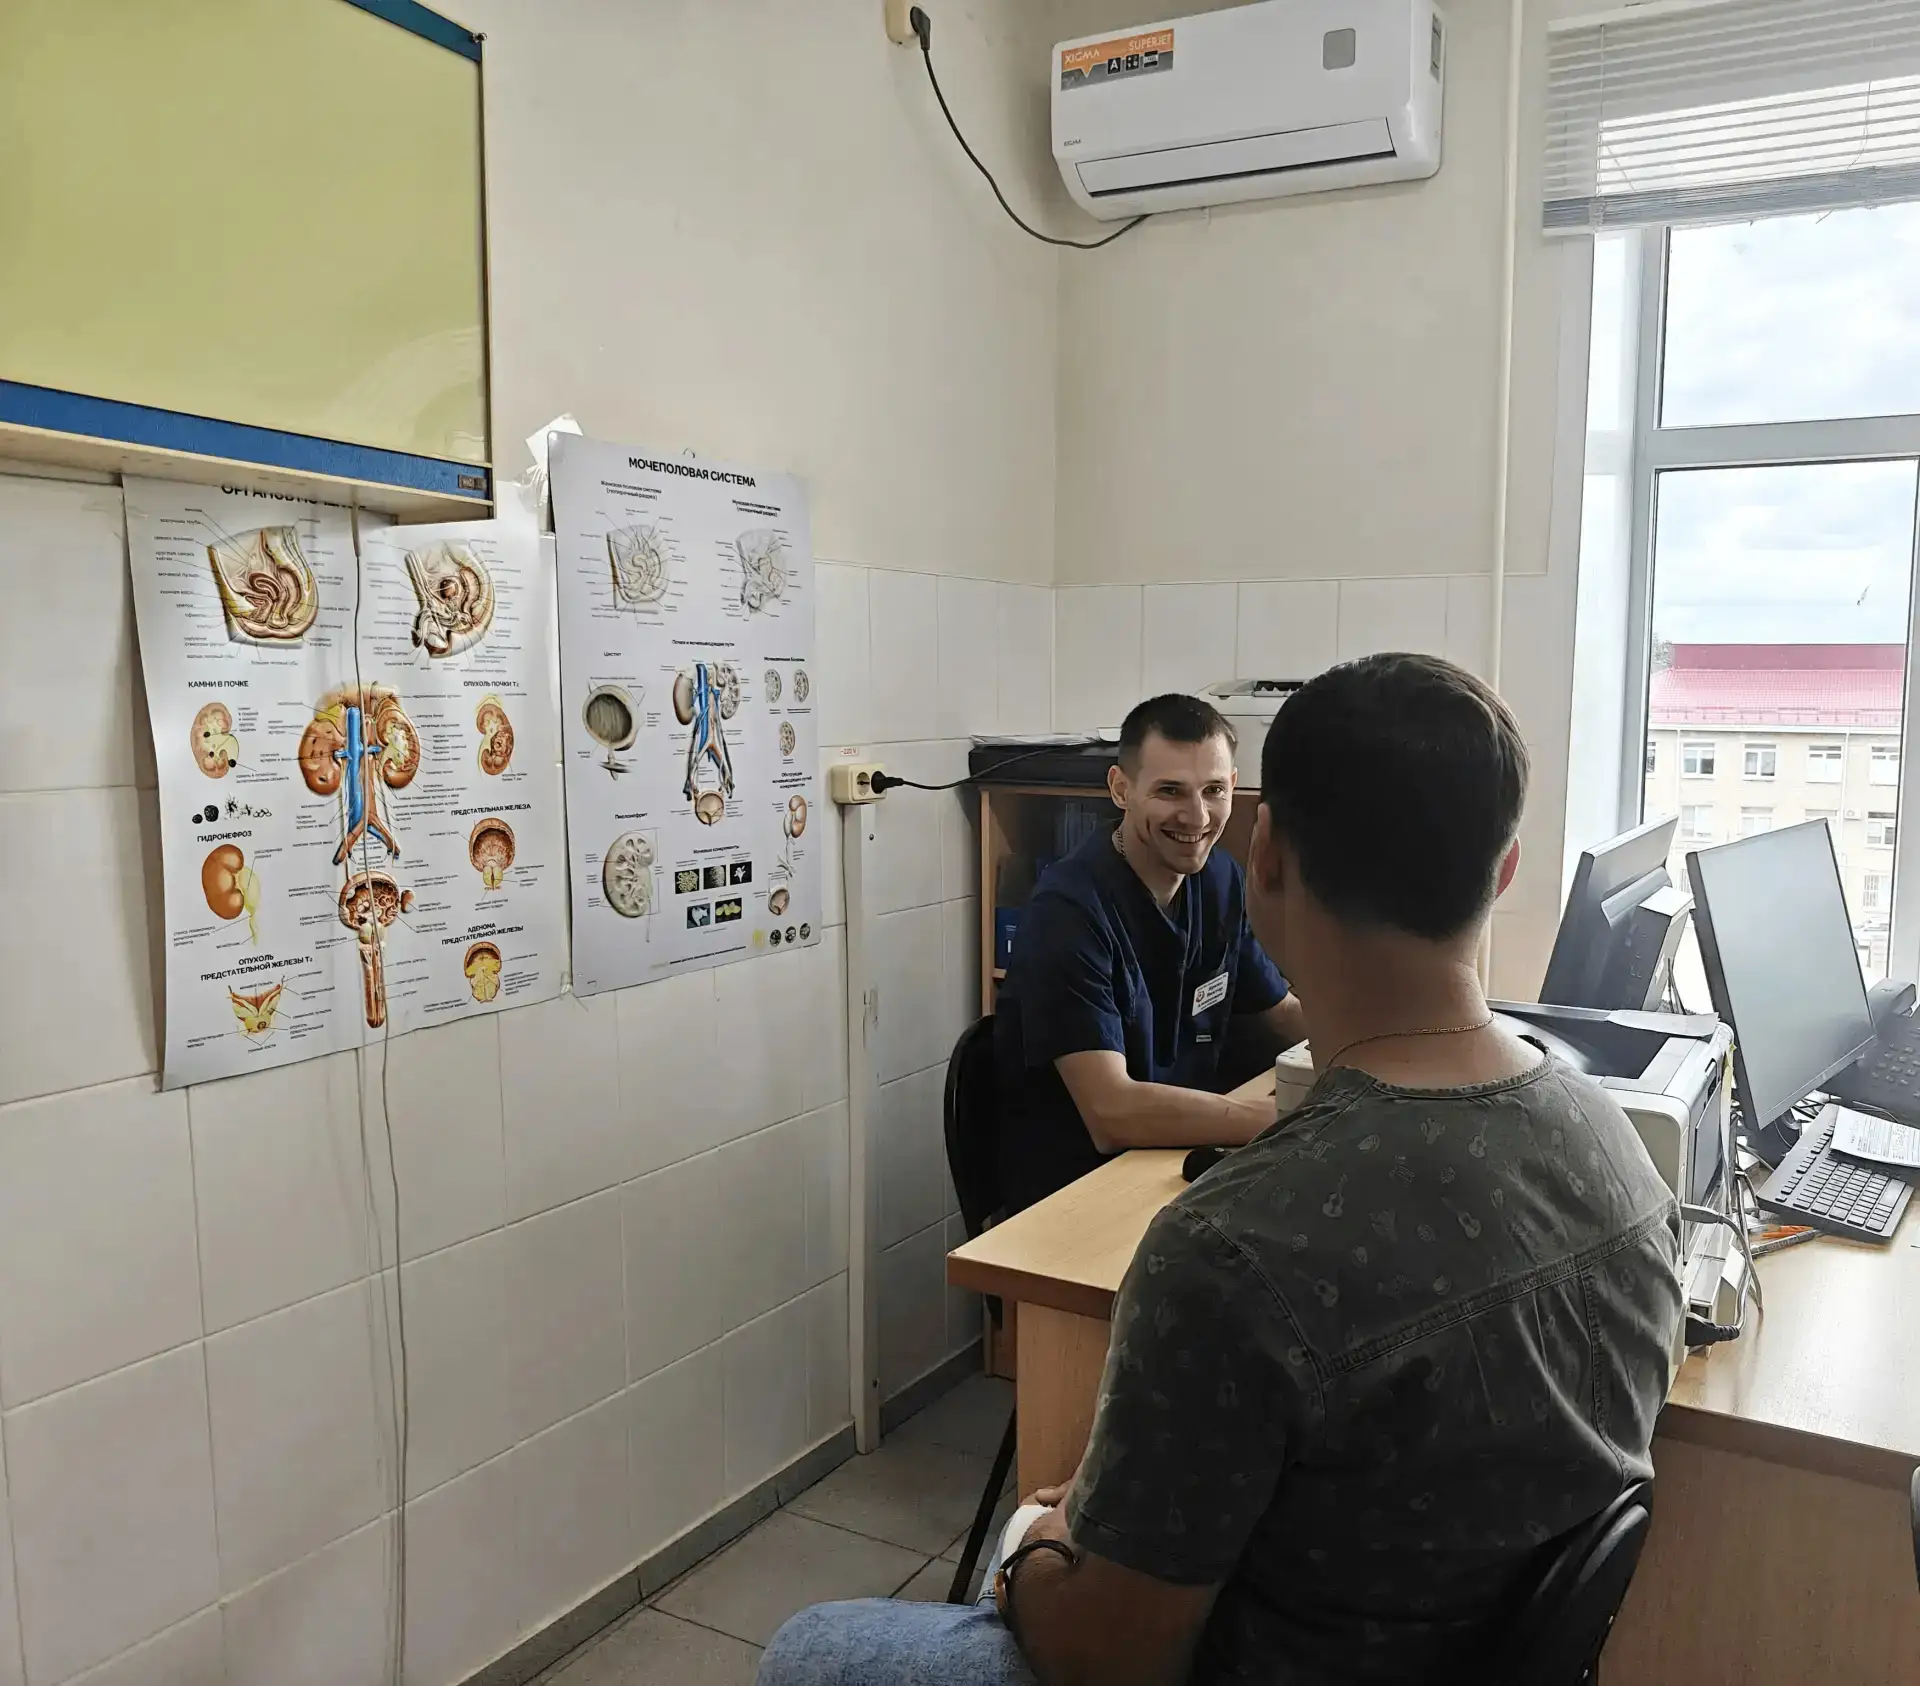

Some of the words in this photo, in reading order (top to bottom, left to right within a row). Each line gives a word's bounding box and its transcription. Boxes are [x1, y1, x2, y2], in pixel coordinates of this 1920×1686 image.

[1129, 33, 1172, 51] SUPERJET
[1065, 49, 1100, 64] XIGMA
[1110, 59, 1119, 70] A
[628, 456, 709, 480] МОЧЕПОЛОВАЯ
[710, 471, 756, 488] СИСТЕМА
[224, 680, 249, 688] ПОЧКЕ
[451, 805, 504, 816] ПРЕДСТАТЕЛЬНАЯ
[505, 803, 531, 811] ЖЕЛЕЗА
[197, 830, 252, 842] ГИДРОНЕФРОЗ
[468, 923, 496, 933] АДЕНОМА
[442, 929, 497, 945] ПРЕДСТАТЕЛЬНОЙ
[497, 926, 524, 935] ЖЕЛЕЗЫ
[239, 954, 274, 965] ОПУХОЛЬ
[201, 962, 271, 981] ПРЕДСТАТЕЛЬНОЙ
[272, 957, 304, 968] ЖЕЛЕЗЫ
